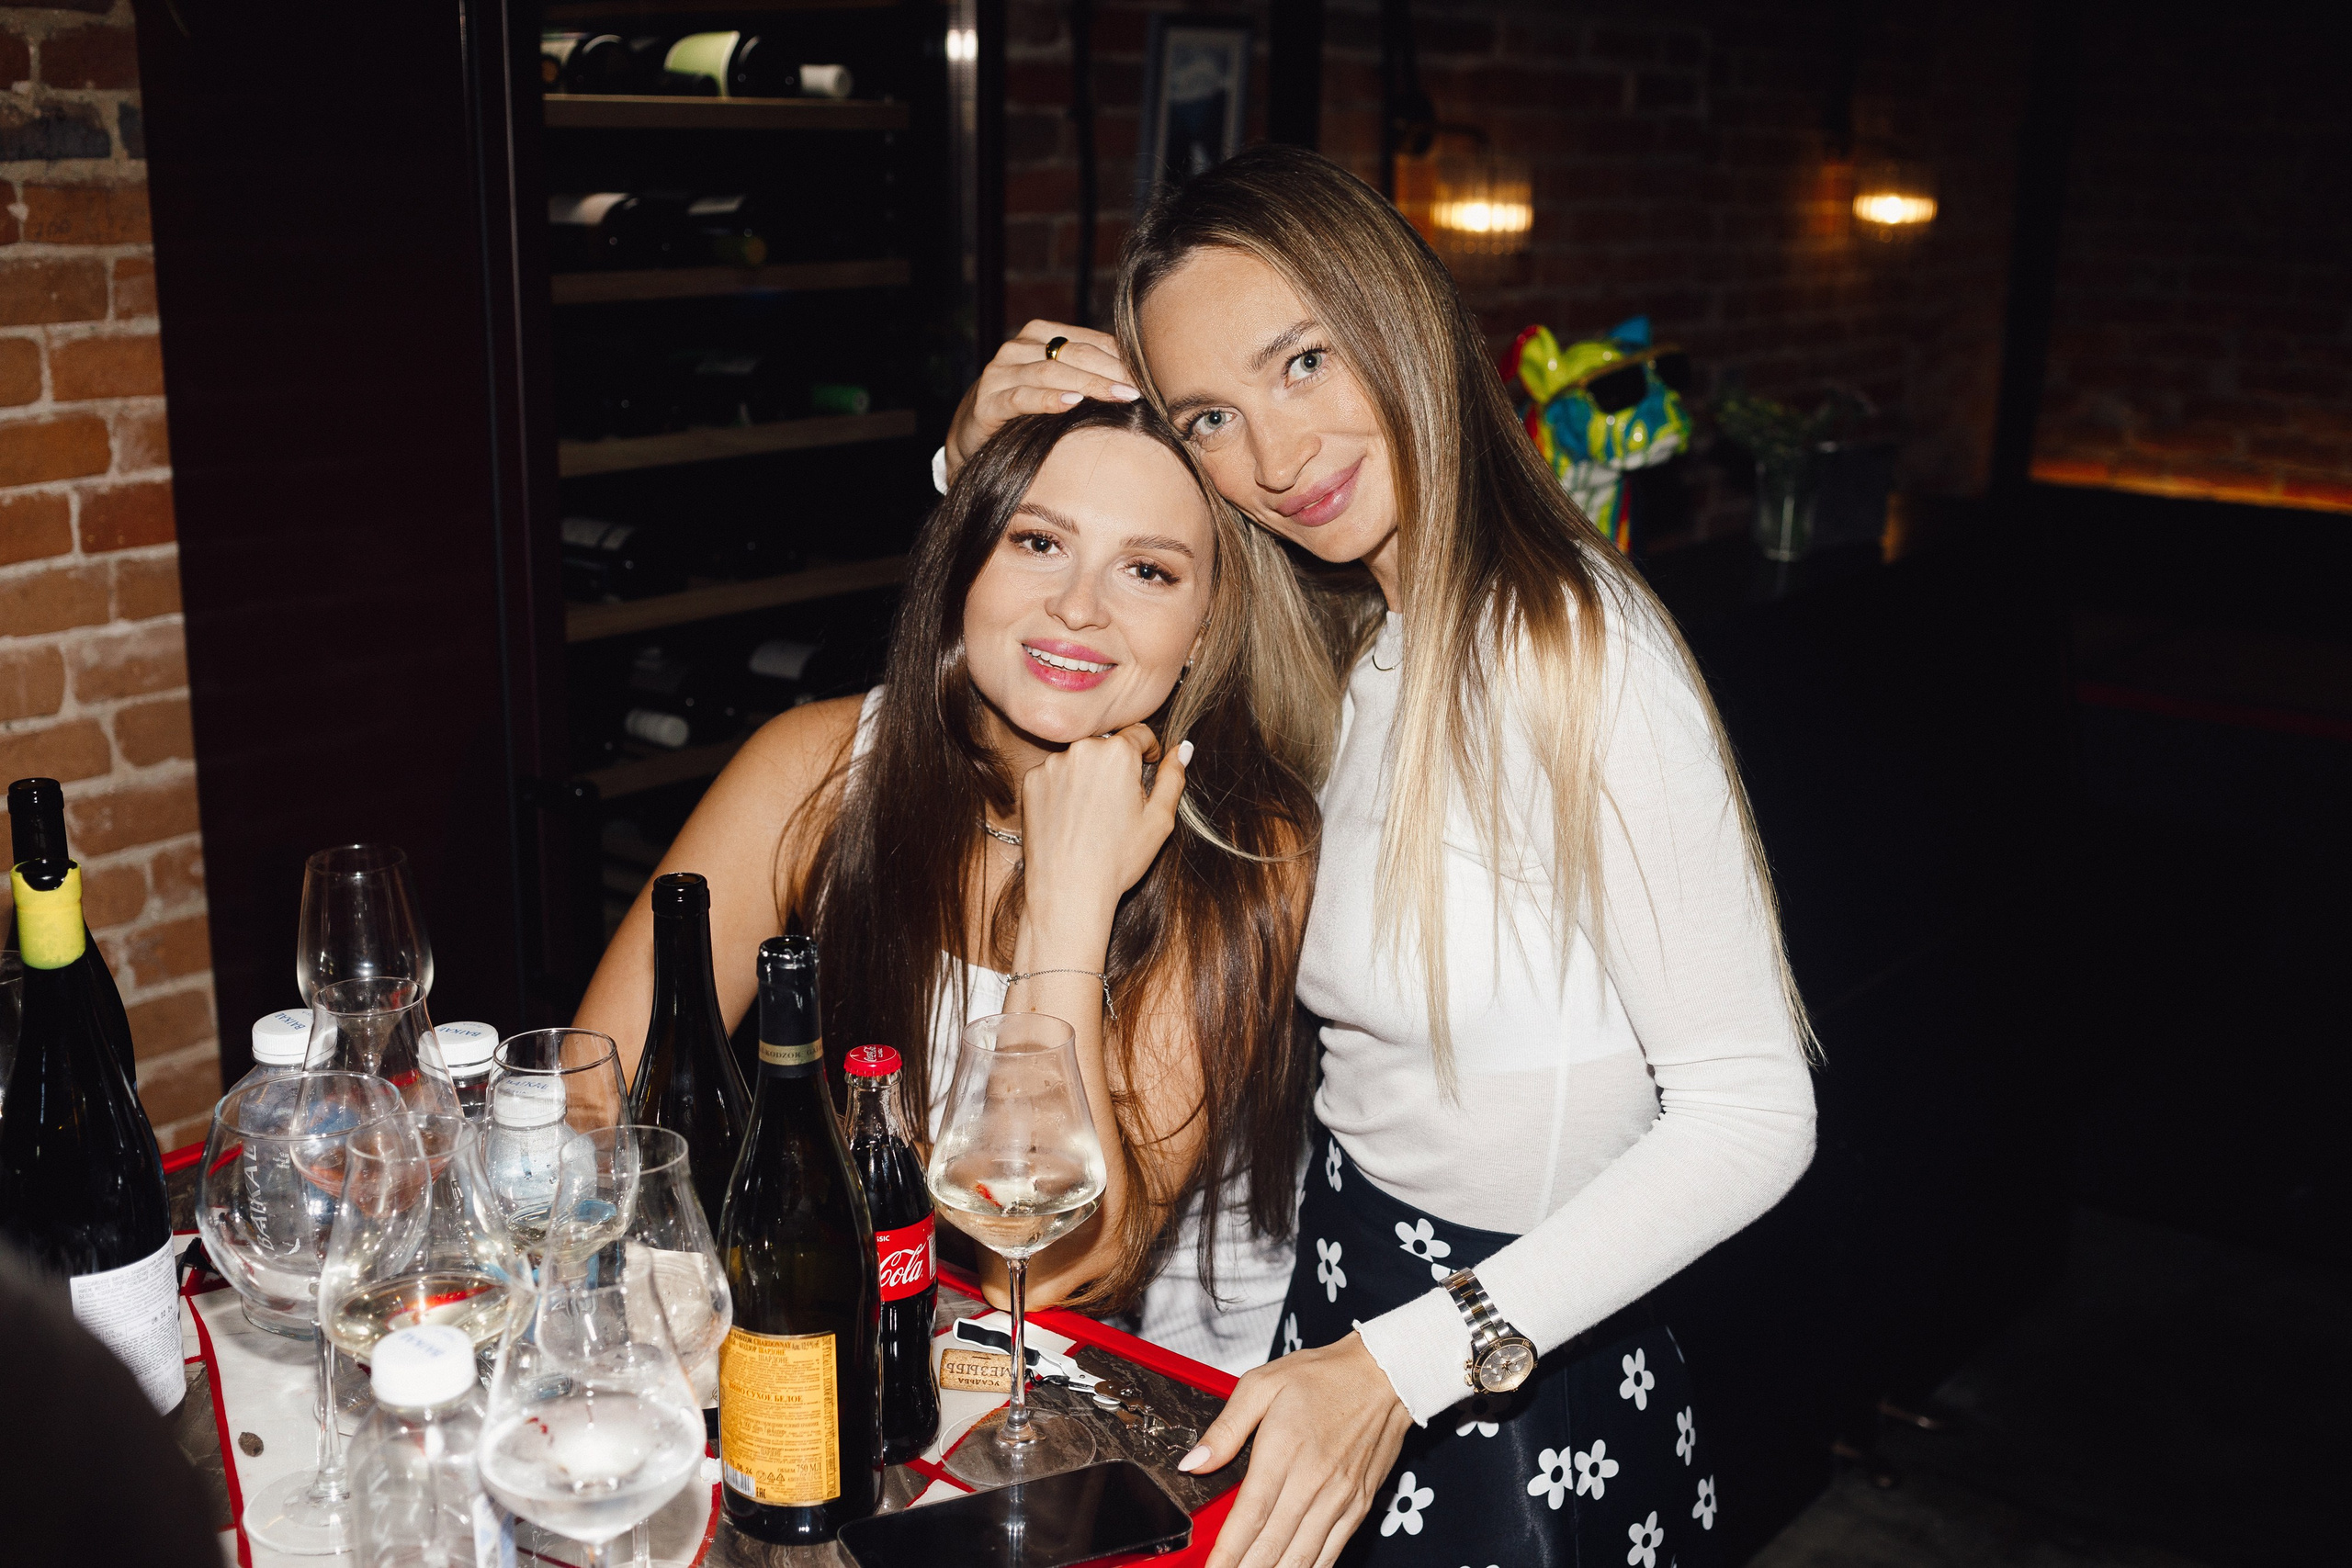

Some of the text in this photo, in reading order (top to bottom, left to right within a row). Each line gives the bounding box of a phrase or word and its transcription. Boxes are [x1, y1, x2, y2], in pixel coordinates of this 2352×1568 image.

[243, 1145, 275, 1251] BAIKAL
[876, 1235, 890, 1243] SSIC
[942, 1362, 1012, 1377] МЕЗЫБЬ
[958, 1377, 1000, 1386] УСАДЬБА
[729, 1382, 745, 1394] ВИНО
[746, 1390, 772, 1402] СУХОЕ
